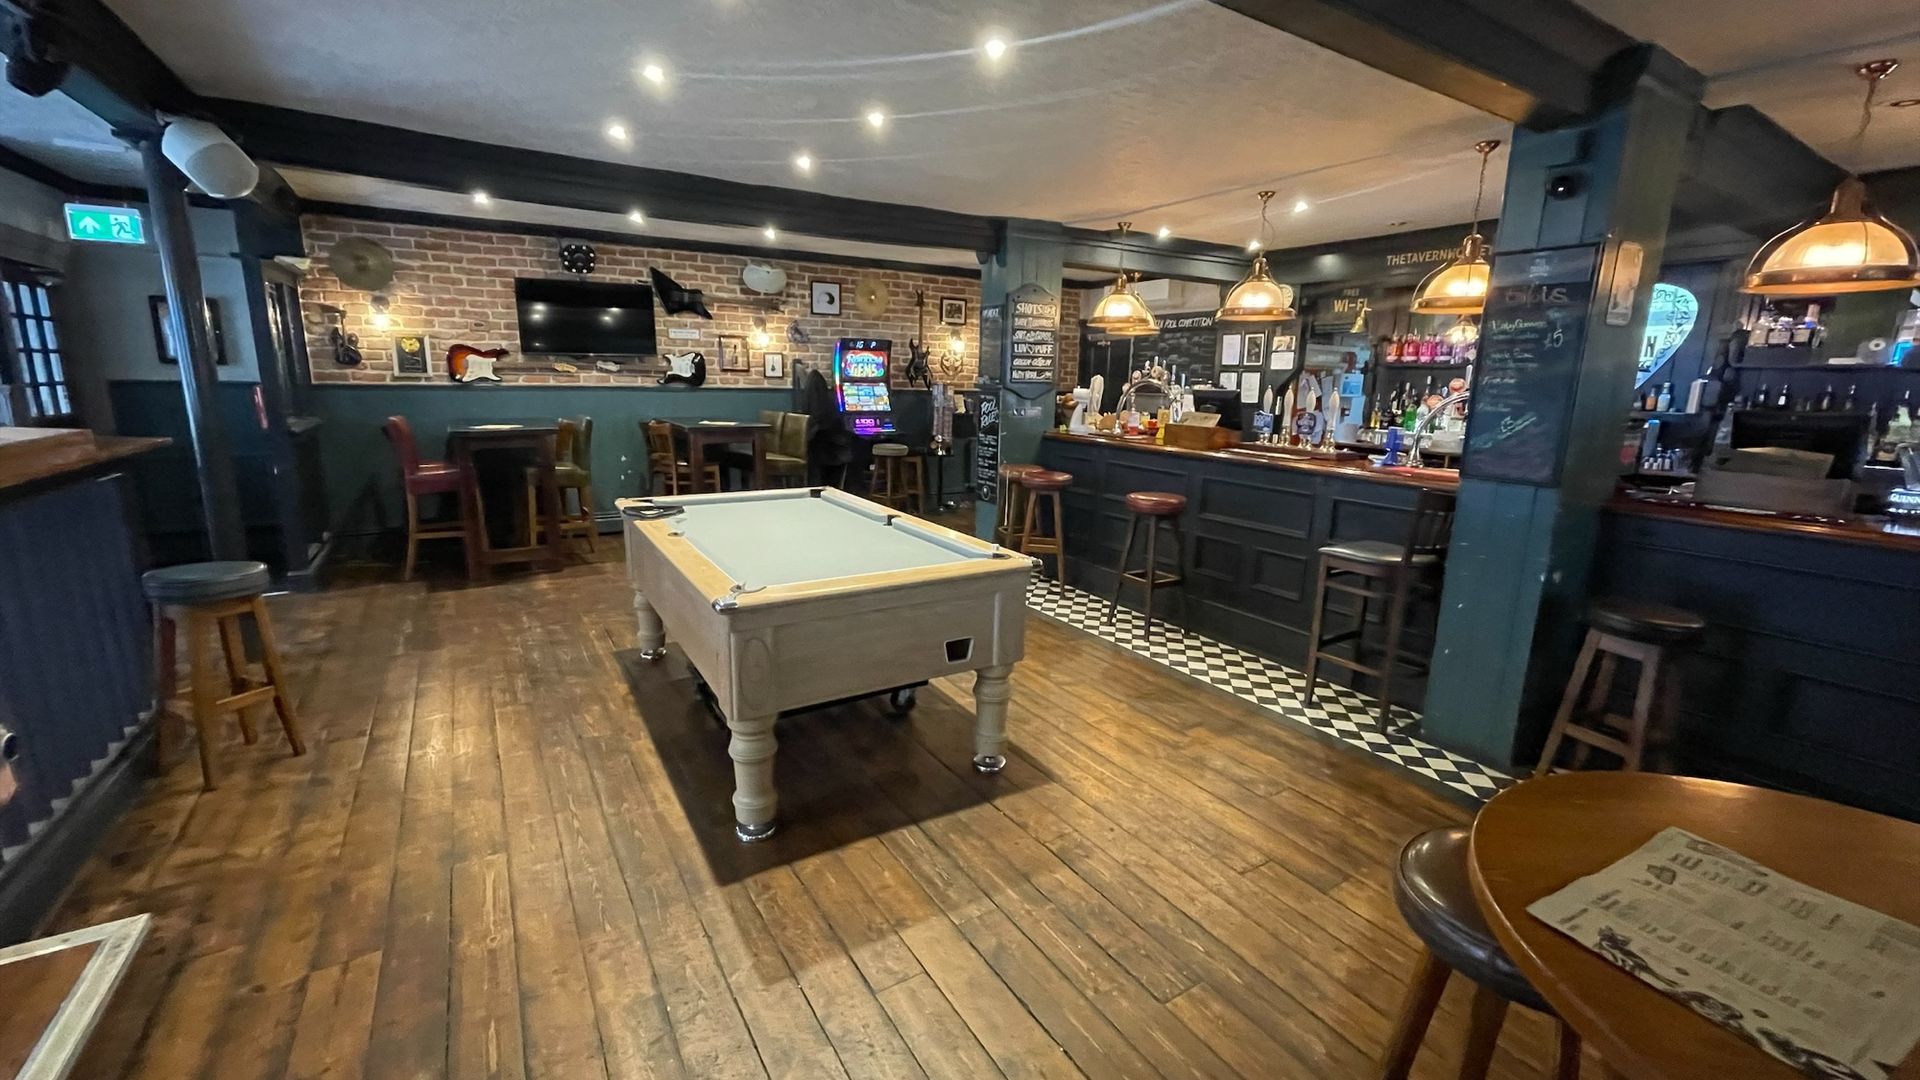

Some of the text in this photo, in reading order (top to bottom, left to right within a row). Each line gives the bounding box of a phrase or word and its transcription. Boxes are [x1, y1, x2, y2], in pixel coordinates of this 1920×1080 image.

[1016, 302, 1042, 315] SHOTS
[1334, 298, 1368, 313] WI-FI
[981, 399, 998, 414] POOL
